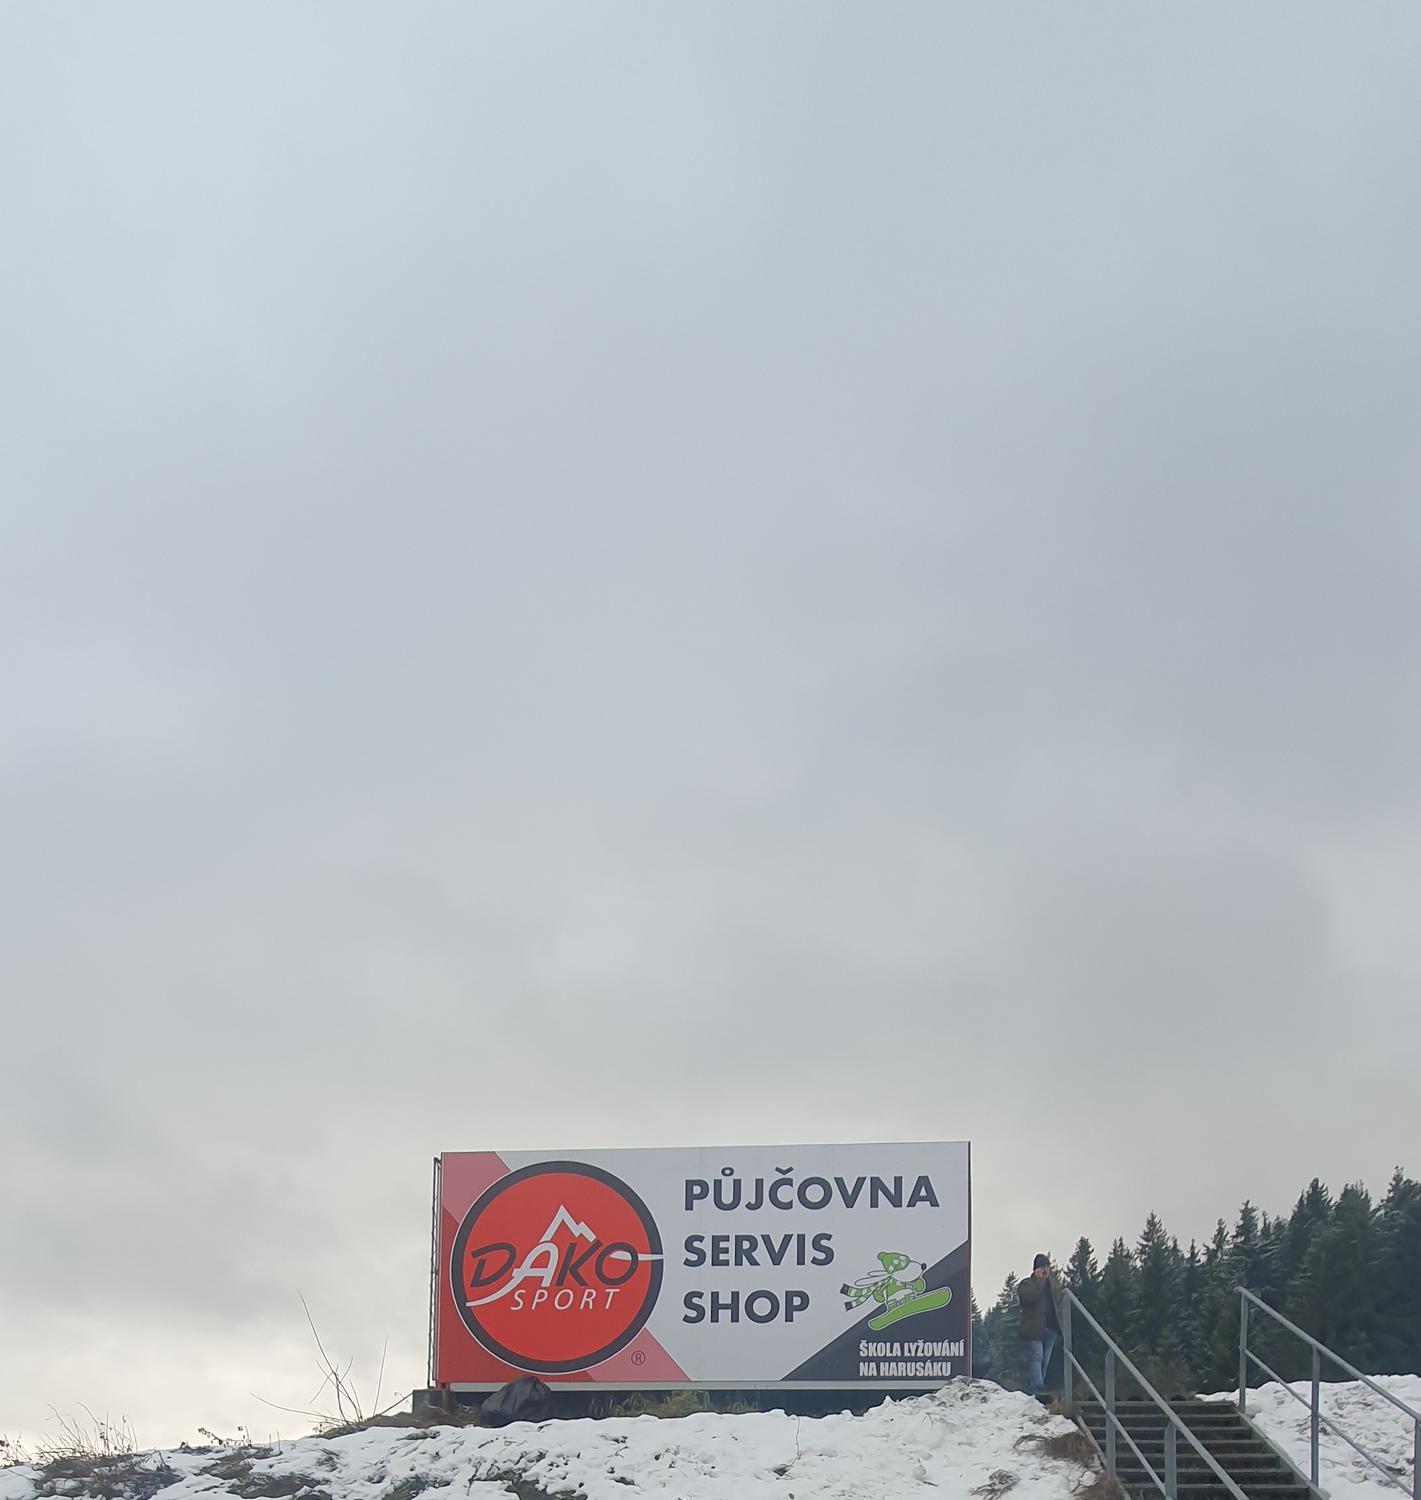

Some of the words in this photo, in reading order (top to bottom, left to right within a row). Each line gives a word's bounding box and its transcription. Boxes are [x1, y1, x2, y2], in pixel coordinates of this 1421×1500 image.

[684, 1166, 940, 1211] PŮJČOVNA
[683, 1232, 835, 1268] SERVIS
[466, 1240, 639, 1304] DAKO
[510, 1288, 621, 1311] SPORT
[682, 1289, 810, 1324] SHOP
[859, 1339, 902, 1357] ŠKOLA
[903, 1338, 965, 1357] LYŽOVÁNÍ
[859, 1361, 878, 1377] NA
[879, 1359, 952, 1377] HARUSÁKU
